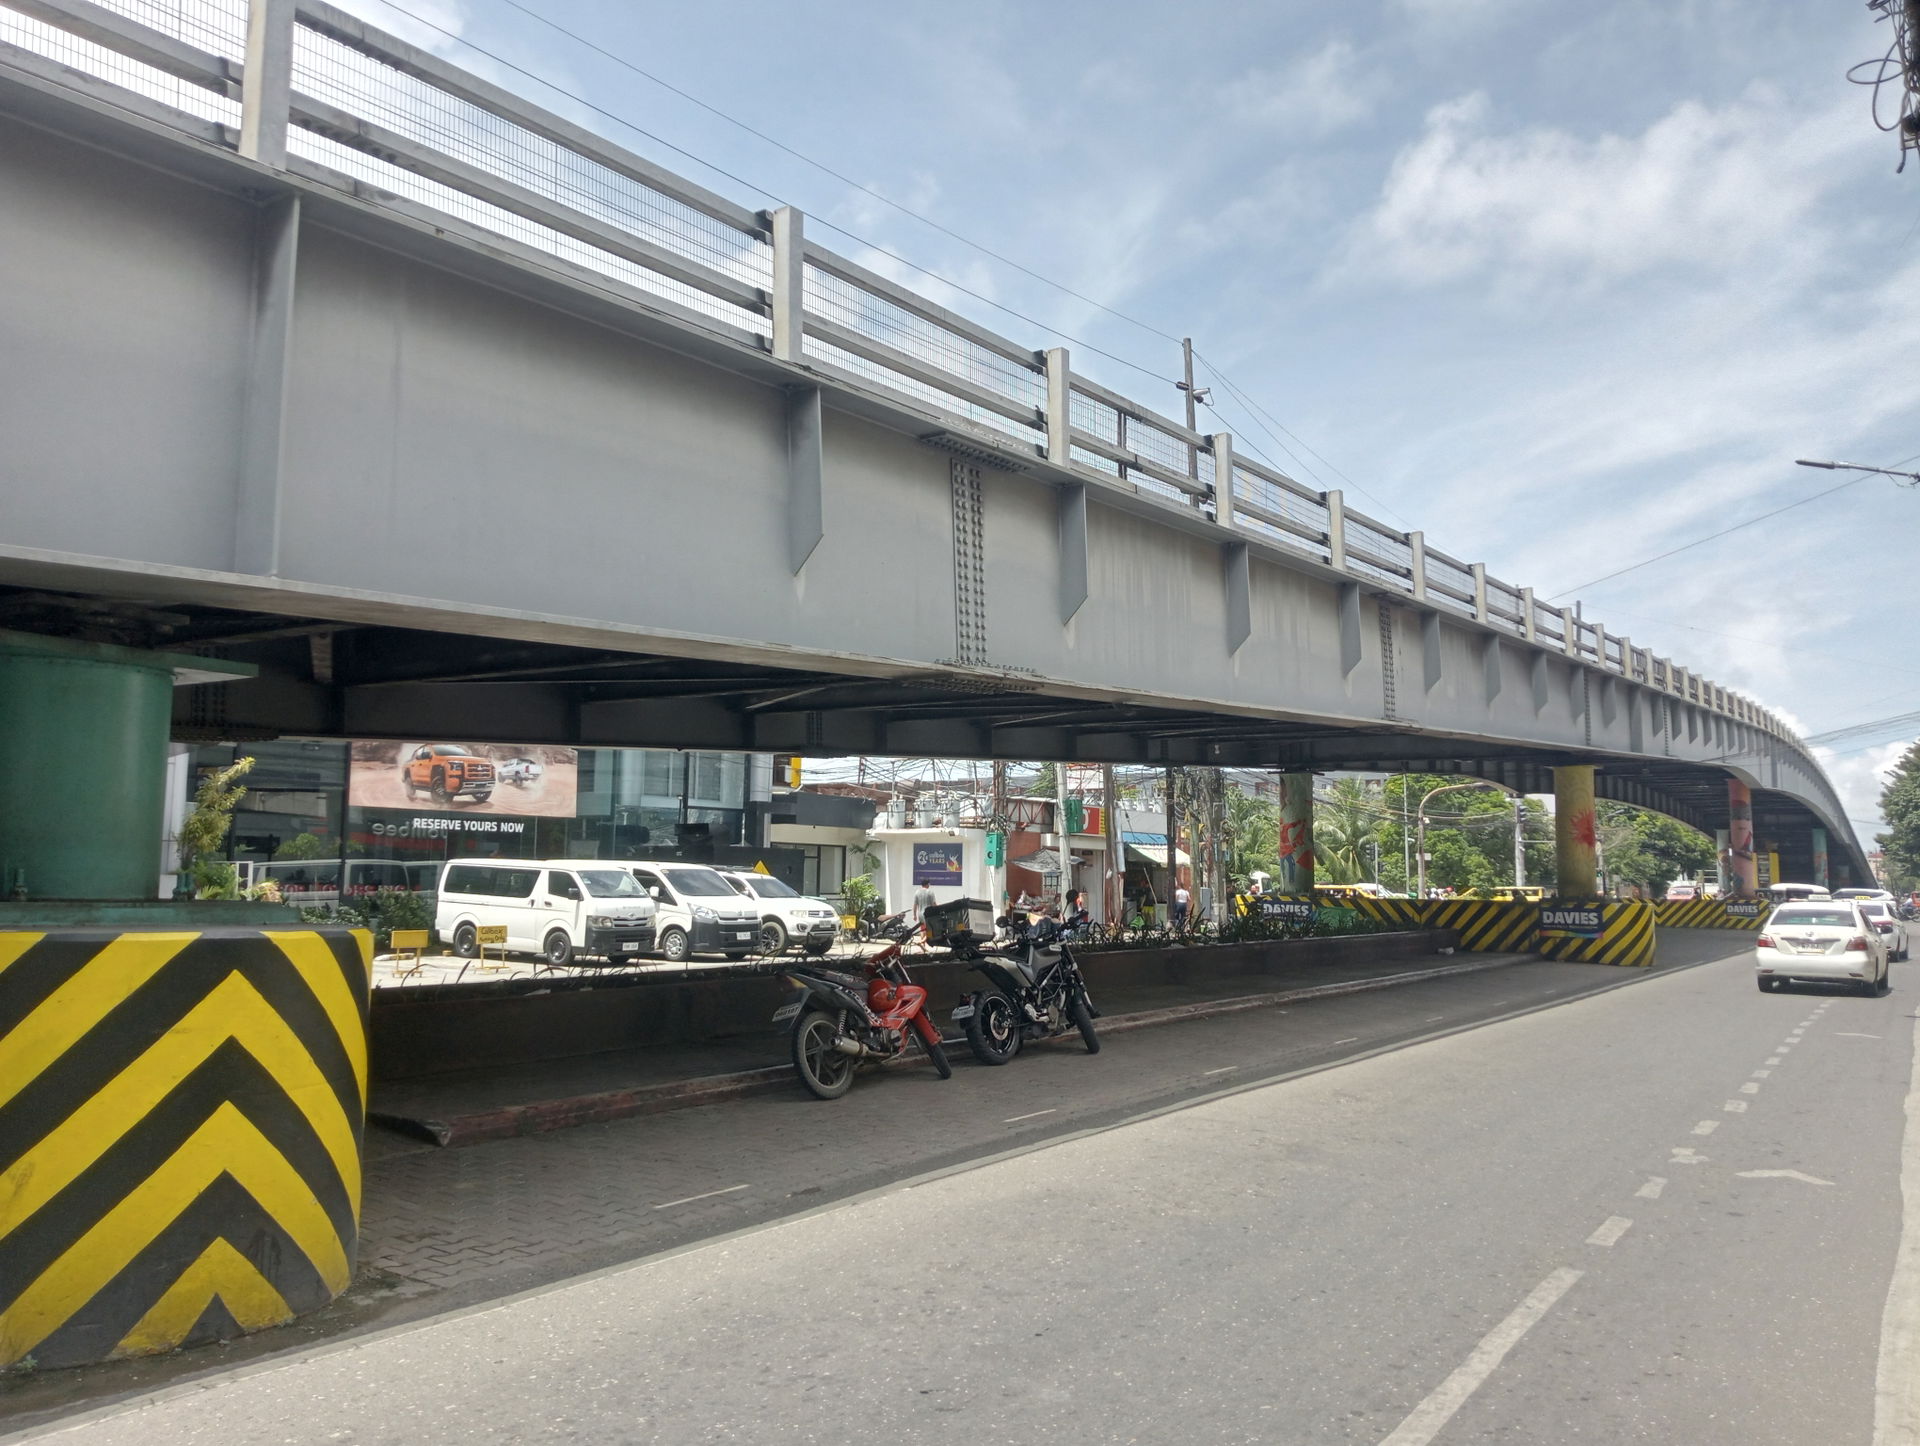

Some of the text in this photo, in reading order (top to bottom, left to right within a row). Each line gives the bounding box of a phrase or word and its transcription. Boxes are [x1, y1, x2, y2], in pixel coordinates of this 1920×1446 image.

[413, 818, 524, 833] RESERVE YOURS NOW
[1543, 911, 1599, 925] DAVIES
